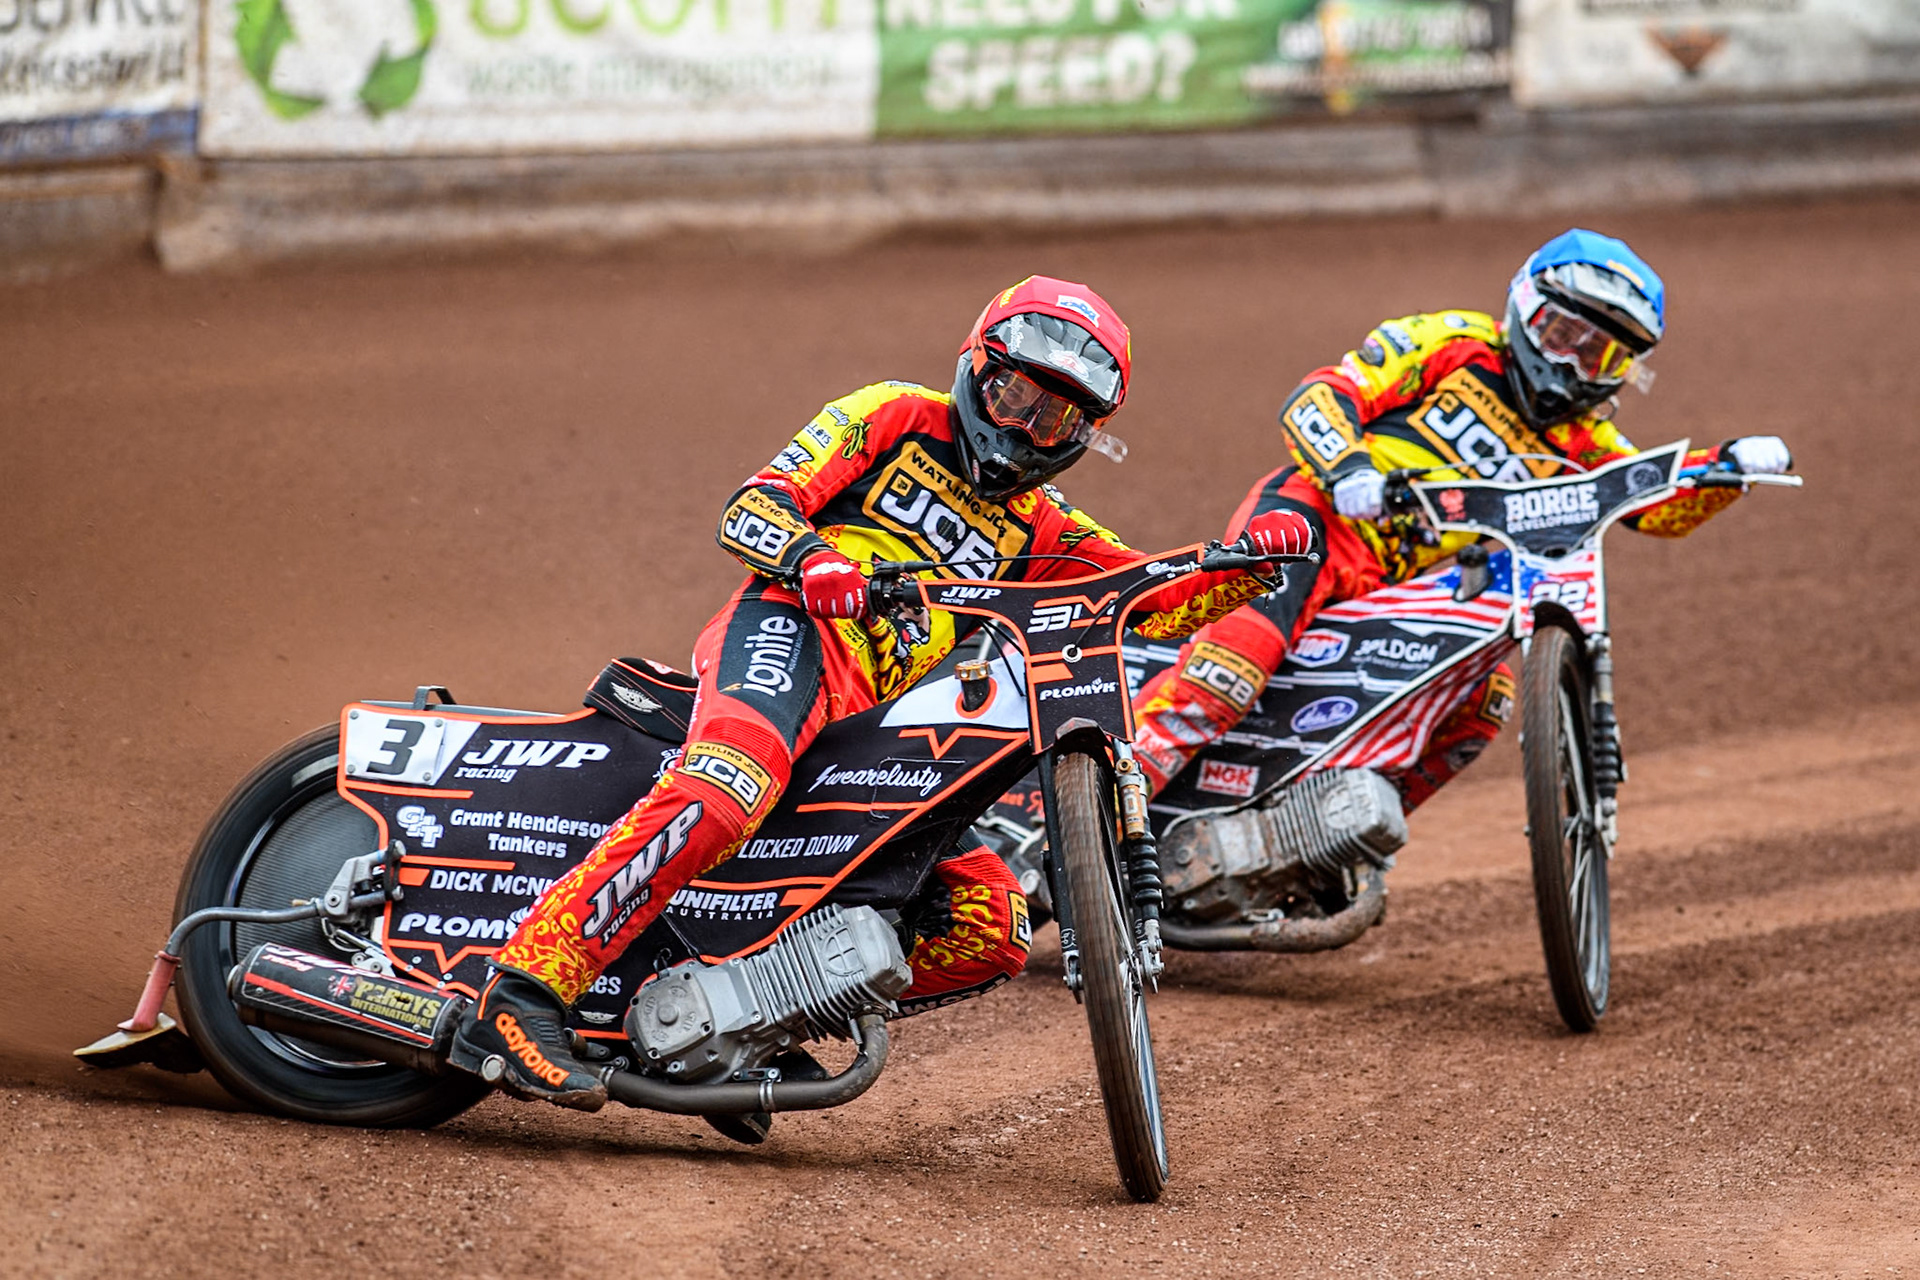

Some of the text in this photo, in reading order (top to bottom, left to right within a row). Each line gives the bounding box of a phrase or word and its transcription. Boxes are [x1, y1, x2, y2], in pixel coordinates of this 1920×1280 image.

[924, 30, 1197, 112] SPEED?
[1291, 404, 1348, 461] JCB
[911, 452, 981, 515] WATLING
[983, 512, 1007, 538] JCB
[1503, 483, 1599, 521] BORGE
[725, 511, 790, 557] JCB
[880, 489, 996, 580] JCB
[1506, 511, 1600, 534] DEVELOPMENT
[940, 586, 1001, 601] JWP
[742, 615, 798, 698] Ignite
[1187, 660, 1255, 706] JCB
[366, 719, 426, 776] 3
[461, 739, 612, 769] JWP
[695, 744, 743, 762] WATLING
[453, 764, 519, 783] racing
[685, 753, 763, 804] JCB
[1203, 761, 1254, 787] NGK
[450, 808, 504, 828] Grant
[487, 833, 568, 858] Tankers
[737, 834, 860, 860] LOCKED DOWN
[430, 869, 488, 893] DICK
[583, 801, 703, 938] JWP
[602, 888, 650, 946] racing
[666, 906, 774, 921] AUSTRALIA
[668, 889, 779, 913] UNIFILTER
[261, 953, 314, 972] racing
[350, 998, 433, 1030] INTERNATIONAL
[353, 980, 442, 1019] PARRYS
[495, 1012, 571, 1087] daytona
